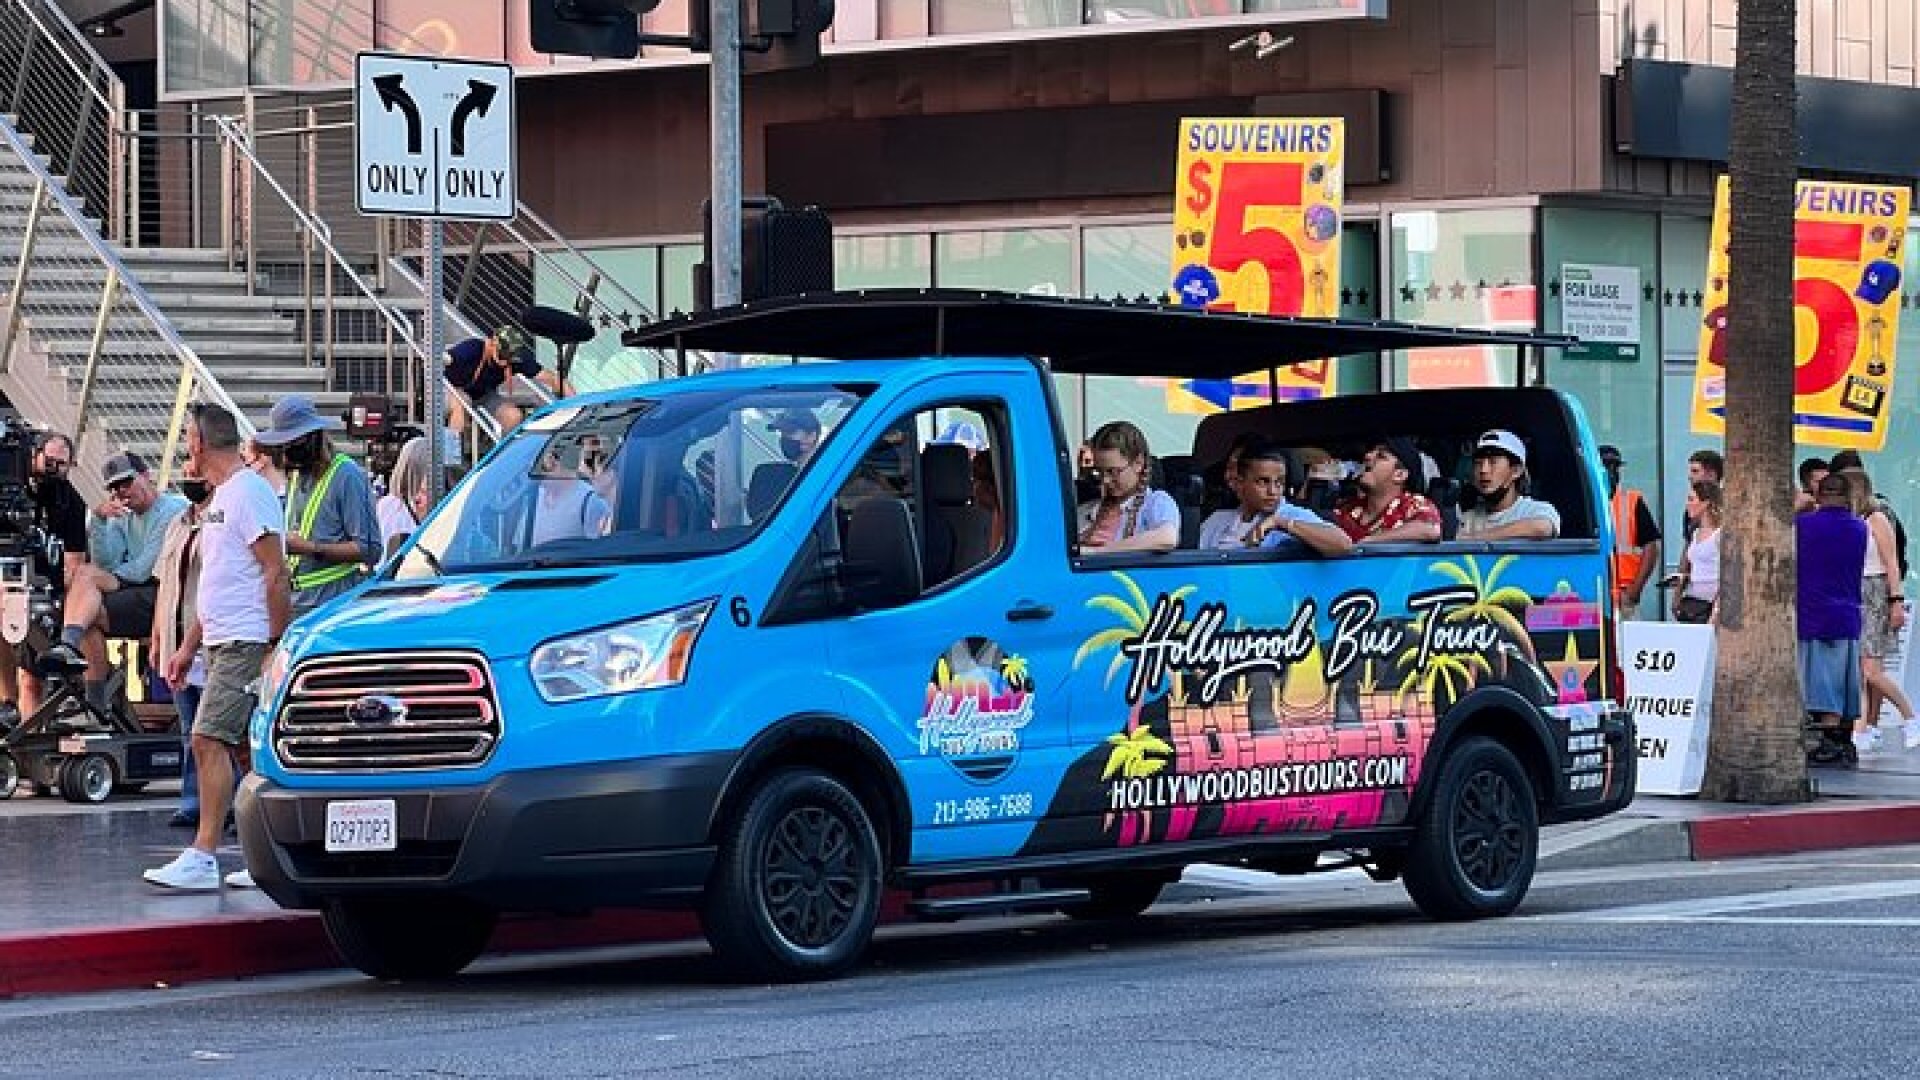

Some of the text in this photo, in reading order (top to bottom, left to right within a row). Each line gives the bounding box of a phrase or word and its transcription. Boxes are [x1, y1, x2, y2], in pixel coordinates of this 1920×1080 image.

[1187, 124, 1332, 153] SOUVENIRS
[367, 163, 428, 195] ONLY
[445, 167, 505, 198] ONLY
[1565, 282, 1619, 299] FOR LEASE
[730, 596, 752, 628] 6
[1124, 587, 1500, 702] Hollywood Bus Tours
[1634, 650, 1676, 673] $10
[1111, 756, 1407, 810] HOLLYWOODBUSTOURS.COM
